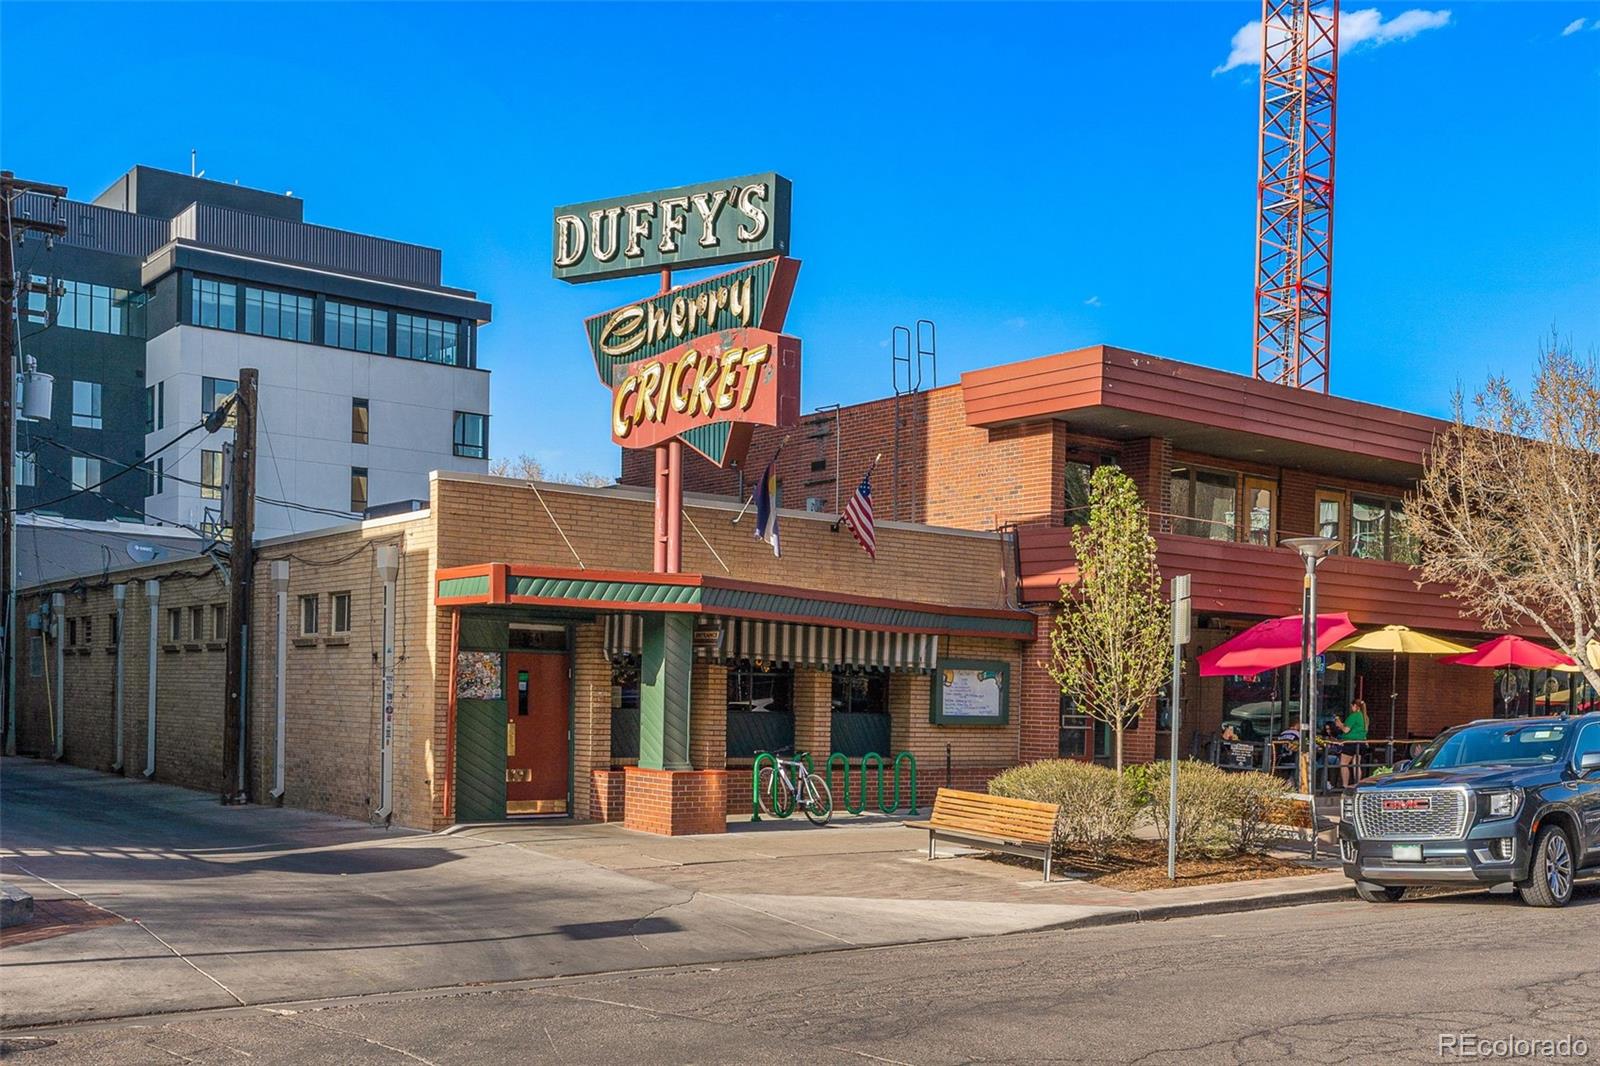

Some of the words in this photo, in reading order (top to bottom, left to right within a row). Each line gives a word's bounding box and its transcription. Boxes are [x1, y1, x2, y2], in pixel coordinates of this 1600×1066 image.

[555, 183, 767, 267] DUFFY'S
[600, 276, 753, 355] Cherry
[613, 344, 771, 438] CRICKET
[1383, 799, 1429, 810] GMC
